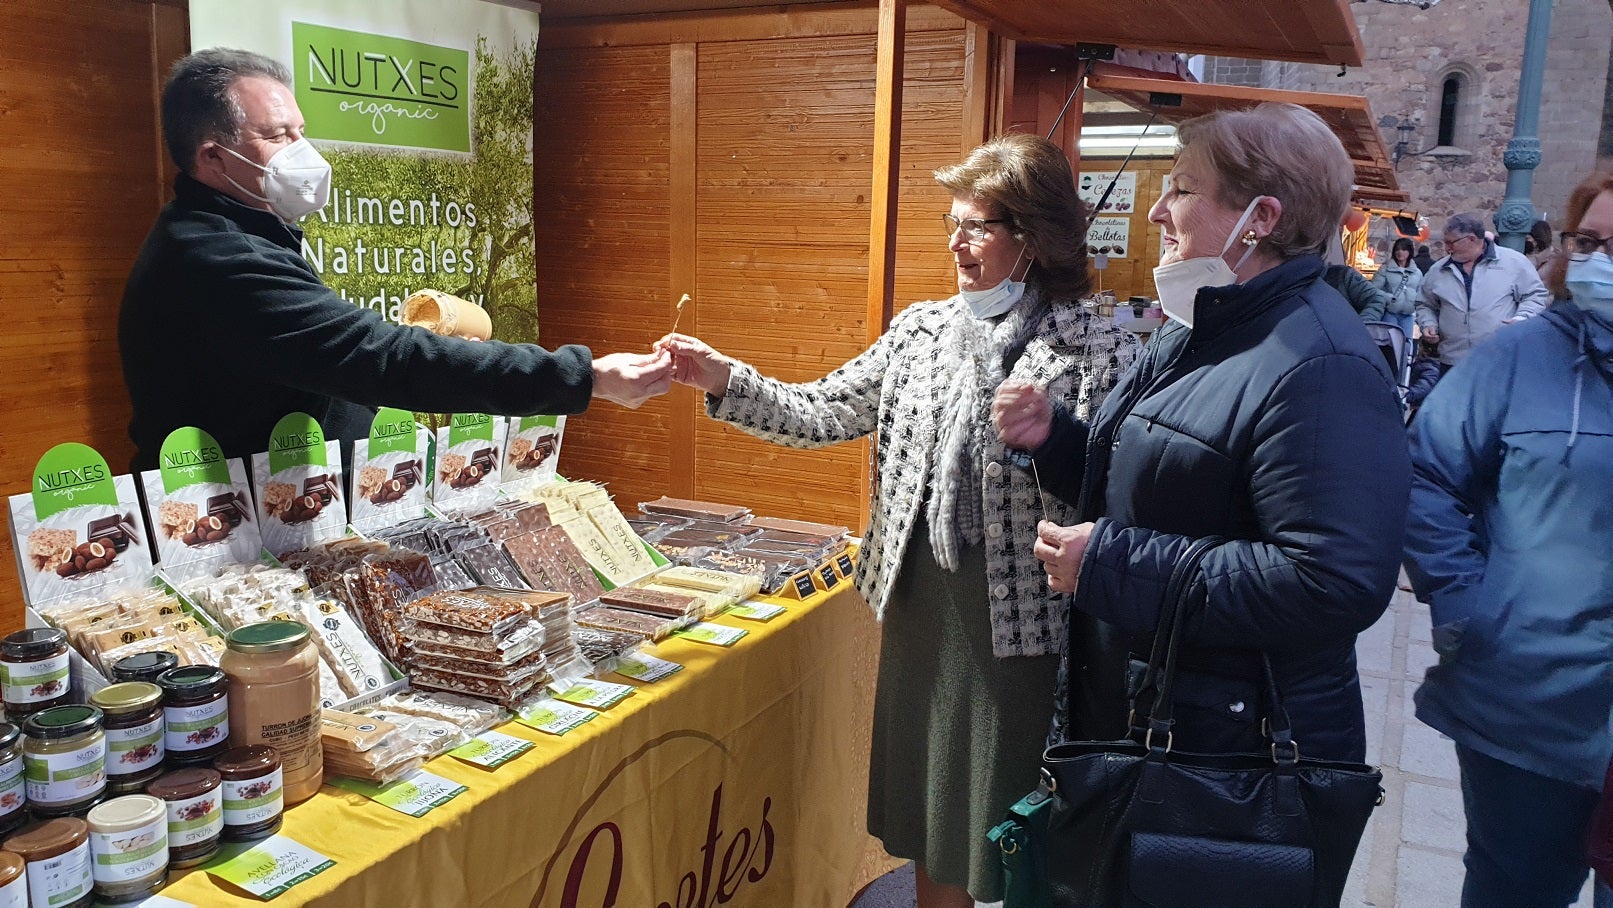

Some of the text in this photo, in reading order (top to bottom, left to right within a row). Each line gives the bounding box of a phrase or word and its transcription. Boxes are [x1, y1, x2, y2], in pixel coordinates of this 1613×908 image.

[309, 44, 458, 101] NUTXES
[339, 99, 439, 135] organic
[1094, 184, 1132, 197] Ceezas
[1088, 230, 1126, 241] Bellotas
[301, 237, 482, 276] Naturales,
[455, 413, 490, 428] NUTXES
[374, 421, 413, 438] NUTXES
[273, 432, 320, 450] NUTXES
[164, 446, 219, 468] NUTXES
[38, 464, 105, 491] NUTXES
[53, 484, 95, 501] organic
[613, 523, 641, 562] NUTXES
[588, 538, 622, 575] NUTXES
[326, 632, 362, 681] NUTXES
[30, 662, 56, 672] NUTXES
[186, 706, 213, 718] NUTXES
[124, 724, 152, 737] NUTXES
[76, 746, 102, 761] NUTXES
[414, 787, 449, 806] JIJONA
[245, 808, 272, 822] NUTXES
[186, 827, 213, 842] NUTXES
[124, 859, 156, 876] NUTXES
[247, 851, 297, 878] AVELLANA
